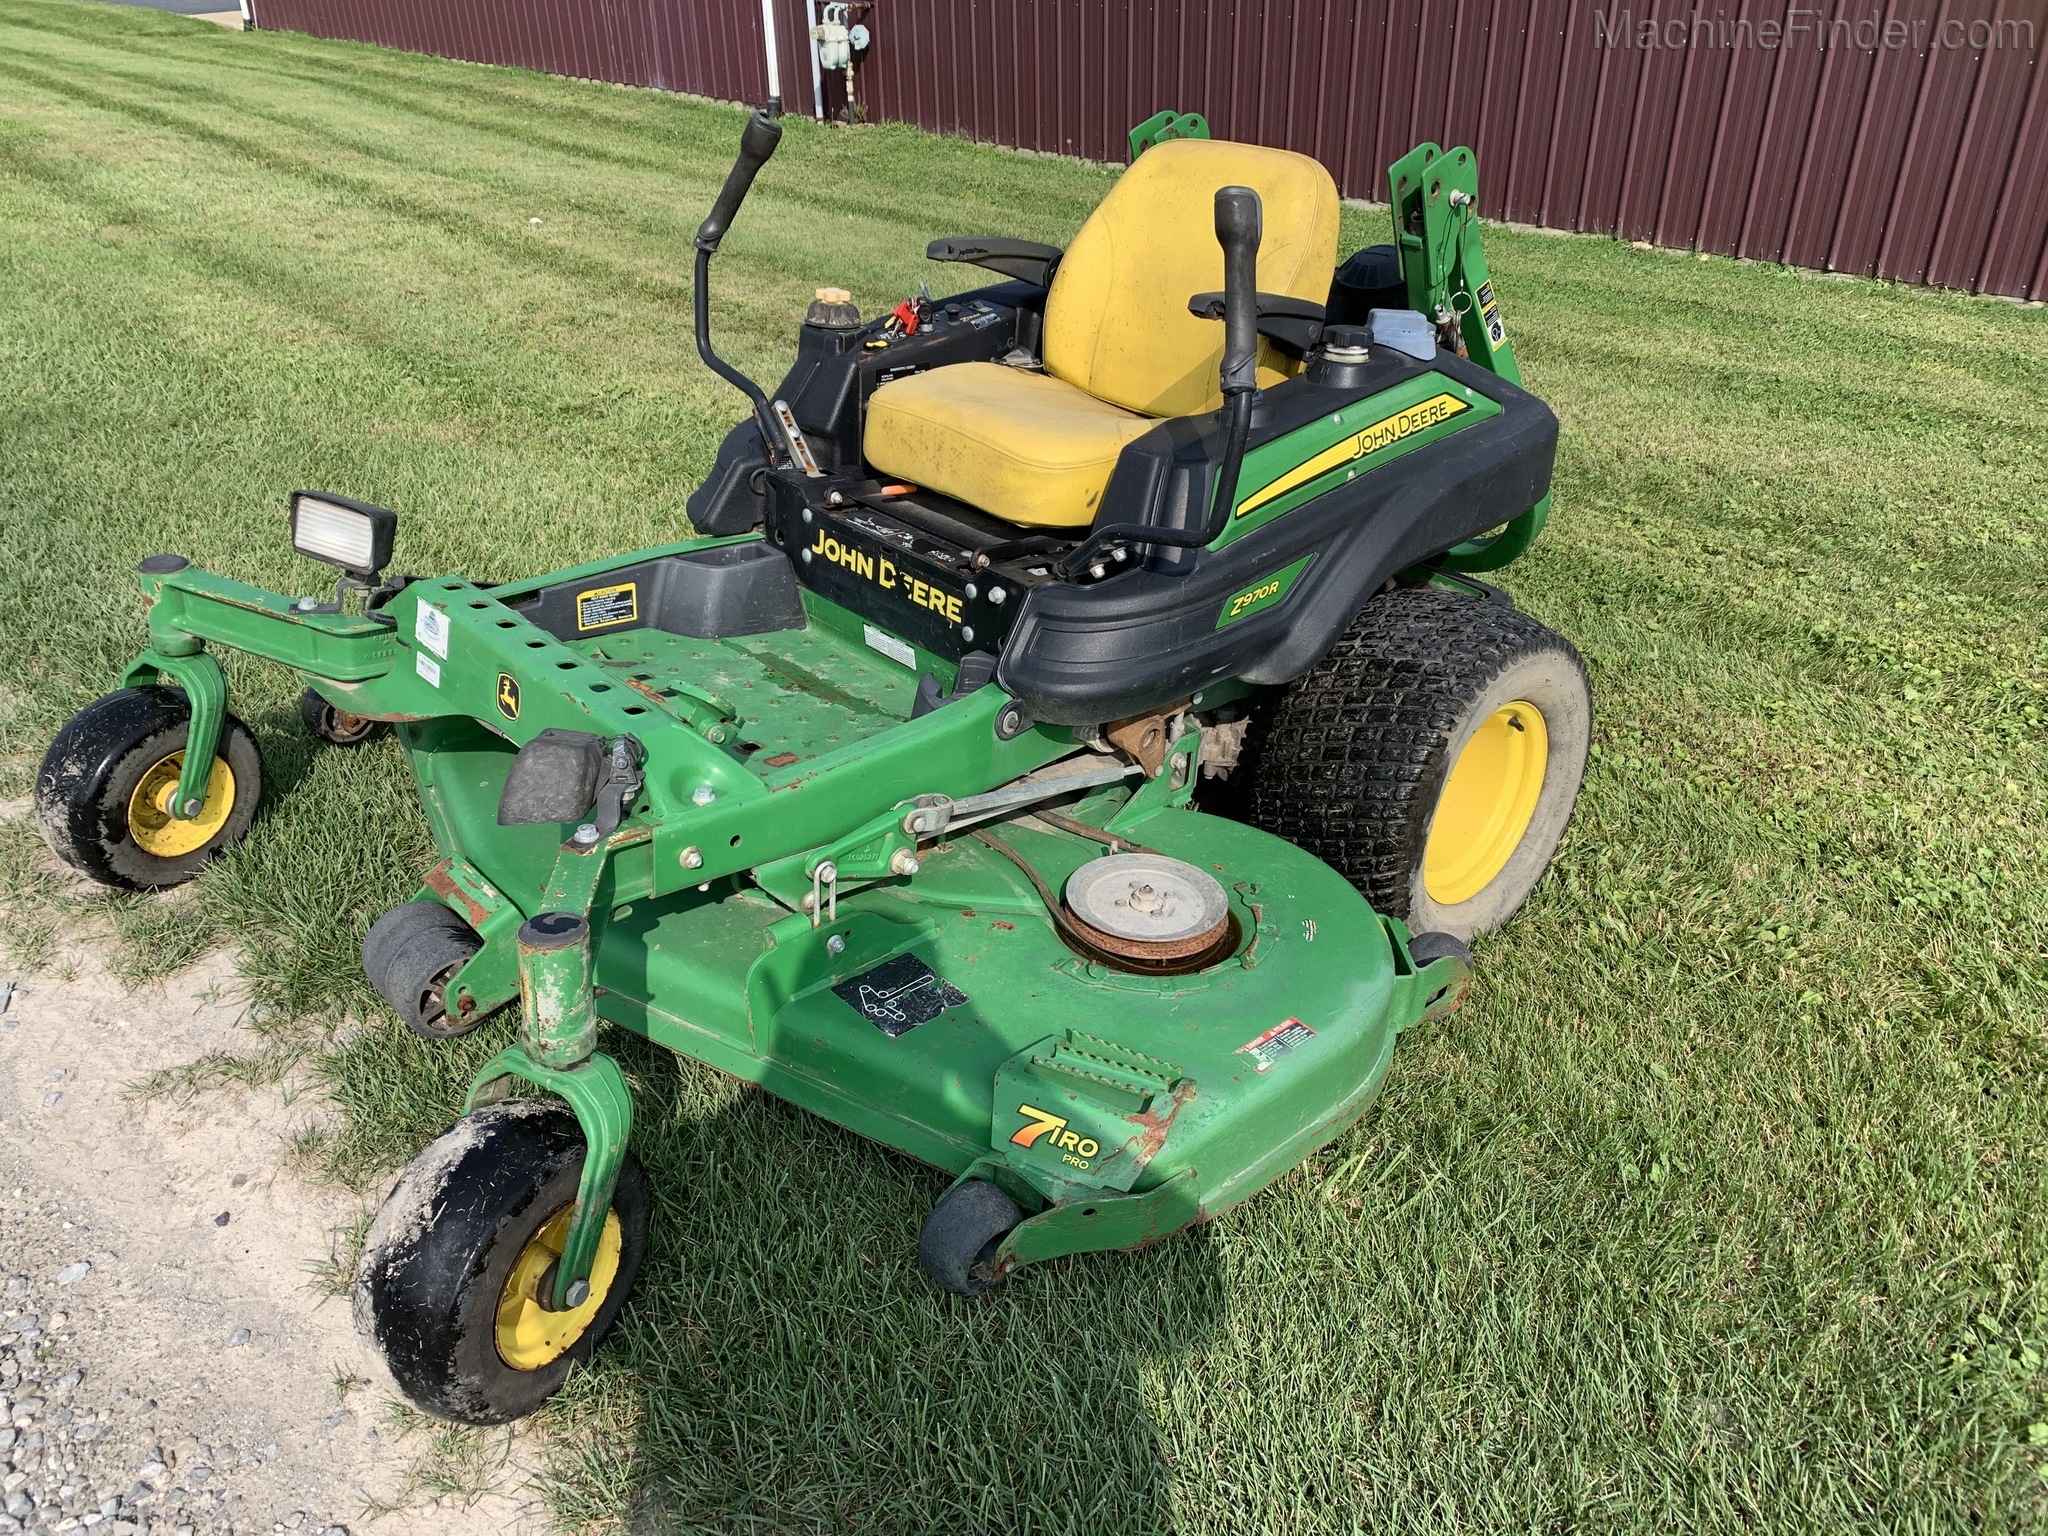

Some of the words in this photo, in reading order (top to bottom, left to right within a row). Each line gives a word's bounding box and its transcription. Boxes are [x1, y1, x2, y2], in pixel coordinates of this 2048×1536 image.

[1353, 423, 1397, 456] JOHN
[1398, 401, 1448, 434] DEERE
[811, 528, 874, 580] JOHN
[1229, 579, 1280, 617] Z970R
[1061, 1152, 1091, 1171] PRO
